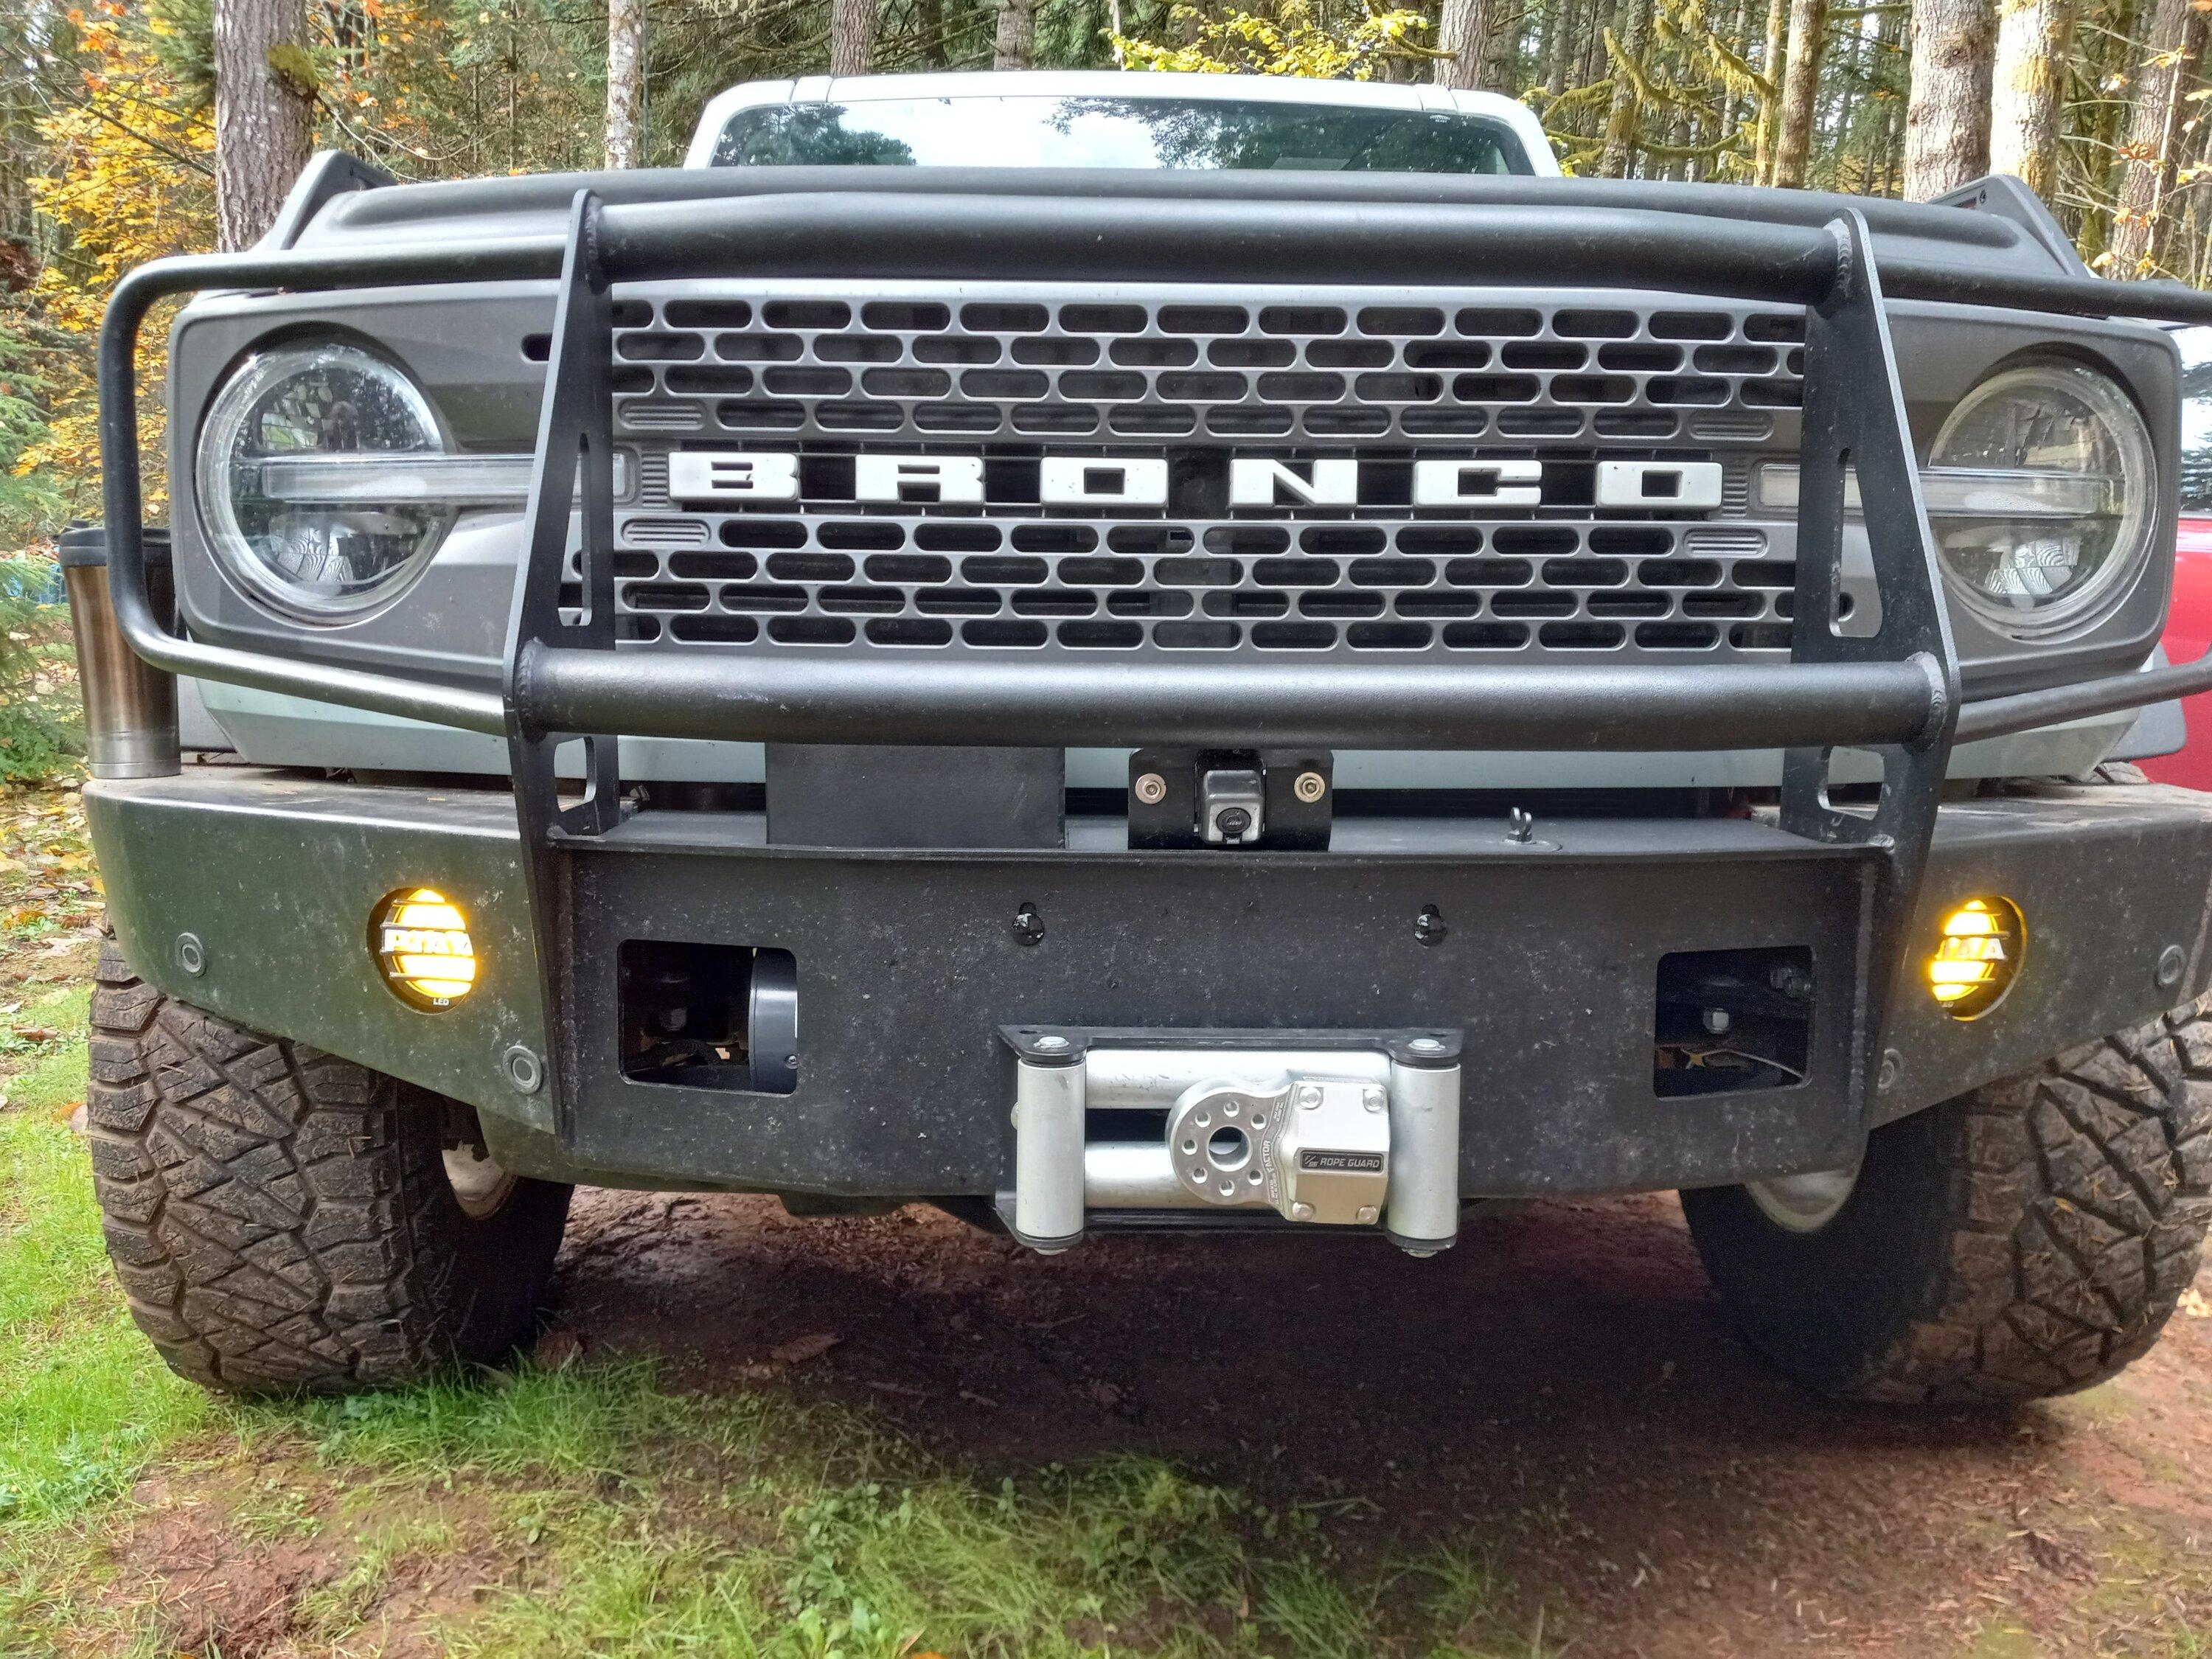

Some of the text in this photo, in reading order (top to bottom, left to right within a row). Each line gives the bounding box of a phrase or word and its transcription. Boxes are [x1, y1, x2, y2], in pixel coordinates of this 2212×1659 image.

[669, 451, 1722, 509] BRONCO
[433, 998, 450, 1006] LED
[1262, 1140, 1275, 1173] FACTOR
[1319, 1157, 1346, 1167] ROPE
[1347, 1158, 1380, 1169] GUARD
